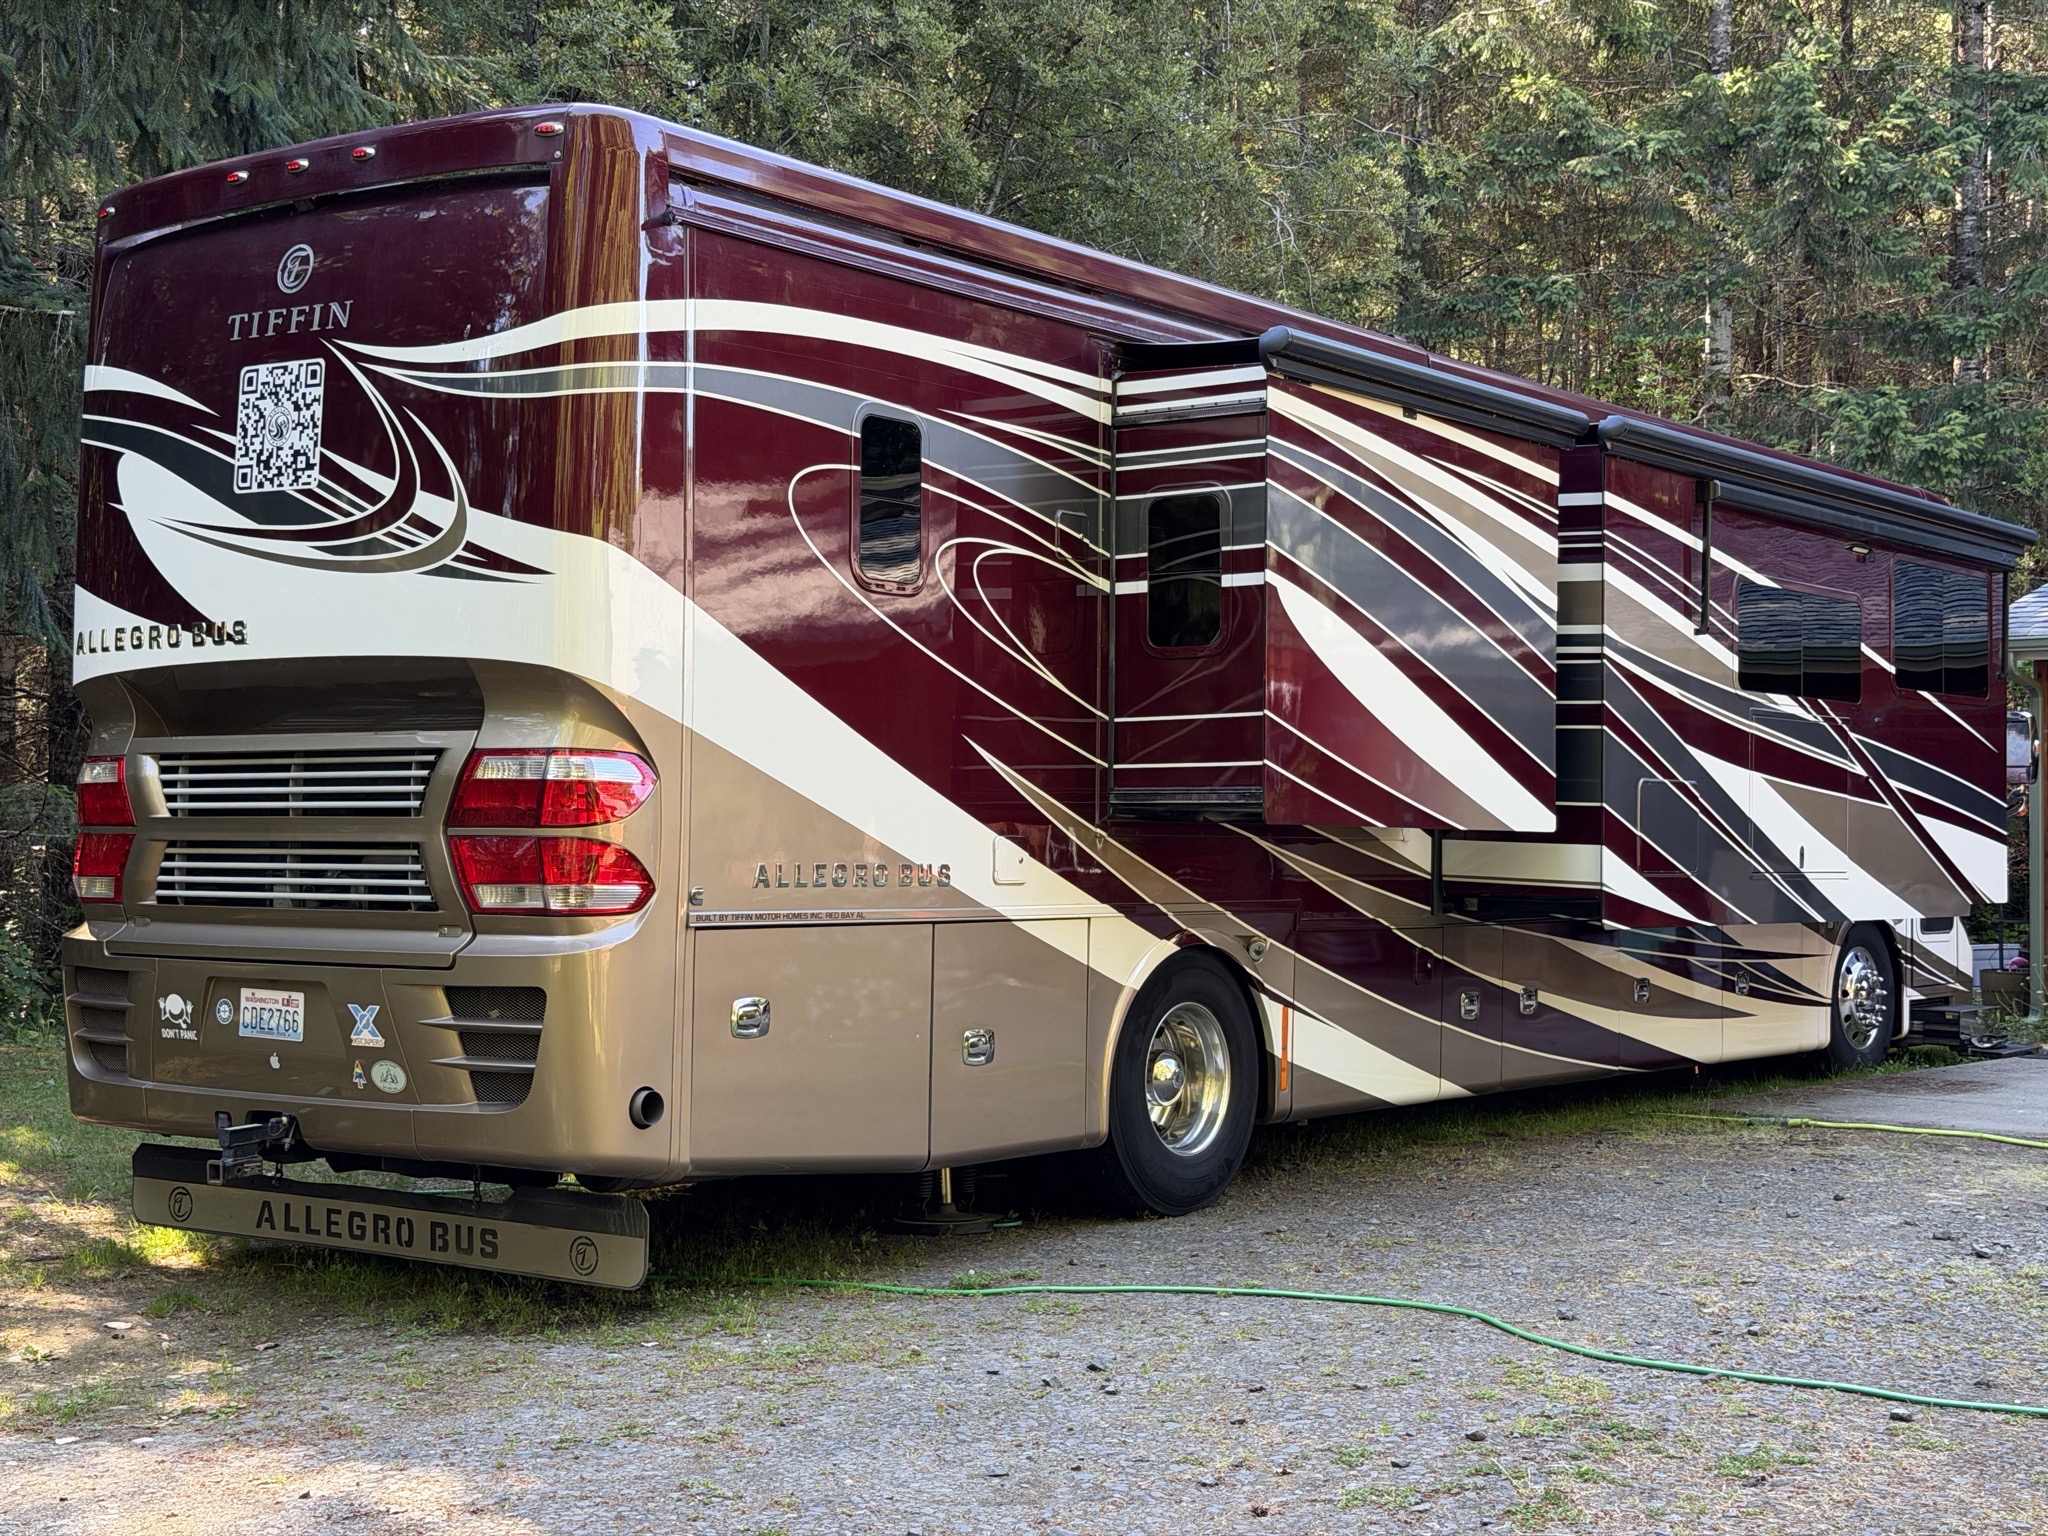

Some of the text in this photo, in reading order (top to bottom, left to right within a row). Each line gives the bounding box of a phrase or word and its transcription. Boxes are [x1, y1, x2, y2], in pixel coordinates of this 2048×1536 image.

[227, 300, 354, 341] TIFFIN
[76, 620, 248, 656] ALLEGRO BUS
[752, 862, 951, 888] ALLEGRO BUS
[695, 914, 718, 922] BUILT
[718, 914, 729, 922] BY
[754, 913, 781, 921] MOTOR
[783, 912, 809, 920] HOMES
[840, 911, 855, 919] BAY
[855, 911, 866, 919] AL
[244, 996, 280, 1005] WASHINGTON
[242, 1006, 300, 1033] CDE2766
[161, 1028, 198, 1041] DON'T PANIC
[352, 1037, 385, 1047] XSCAPERS
[255, 1200, 499, 1260] ALLEGRO BUS
